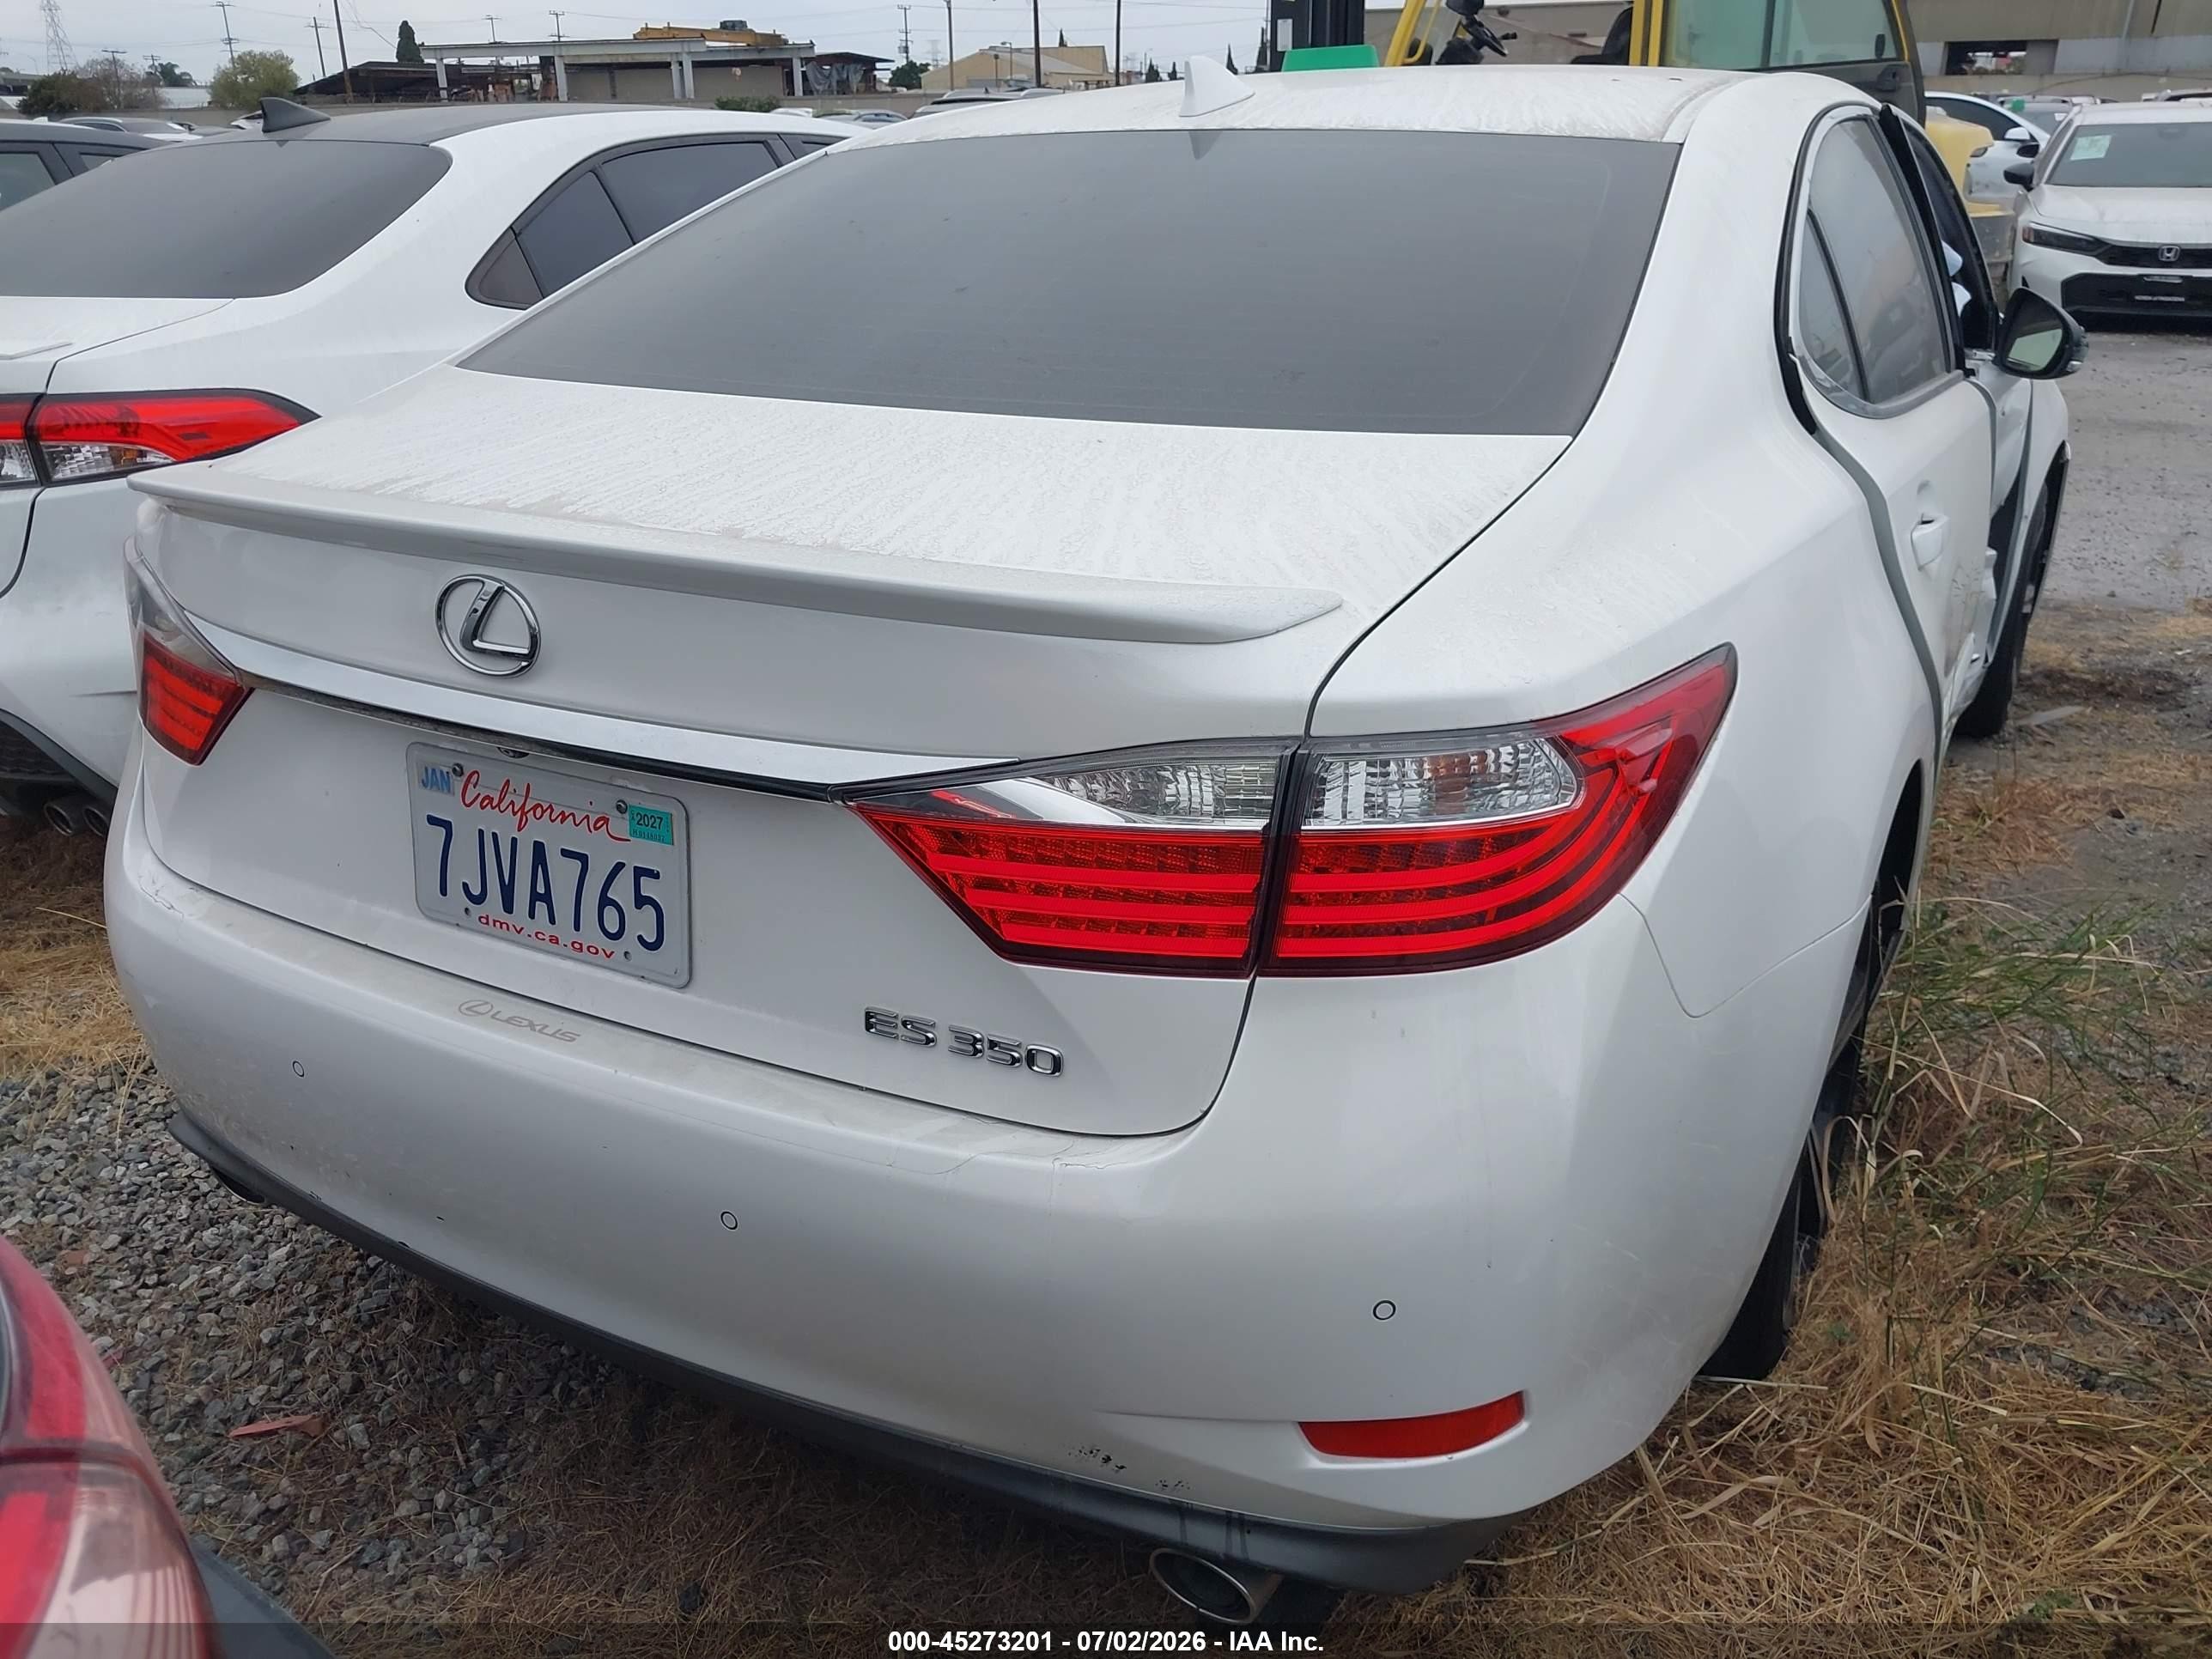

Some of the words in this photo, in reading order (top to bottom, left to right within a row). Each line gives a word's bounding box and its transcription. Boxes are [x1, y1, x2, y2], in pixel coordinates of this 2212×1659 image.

[422, 766, 451, 793] JAN
[459, 769, 631, 842] California
[635, 811, 663, 830] 2027
[426, 813, 665, 952] 7JVA765
[477, 914, 616, 960] dmv.ca.gov
[490, 1011, 581, 1042] LEXUS
[865, 1006, 938, 1048] ES
[948, 1024, 1065, 1078] 350
